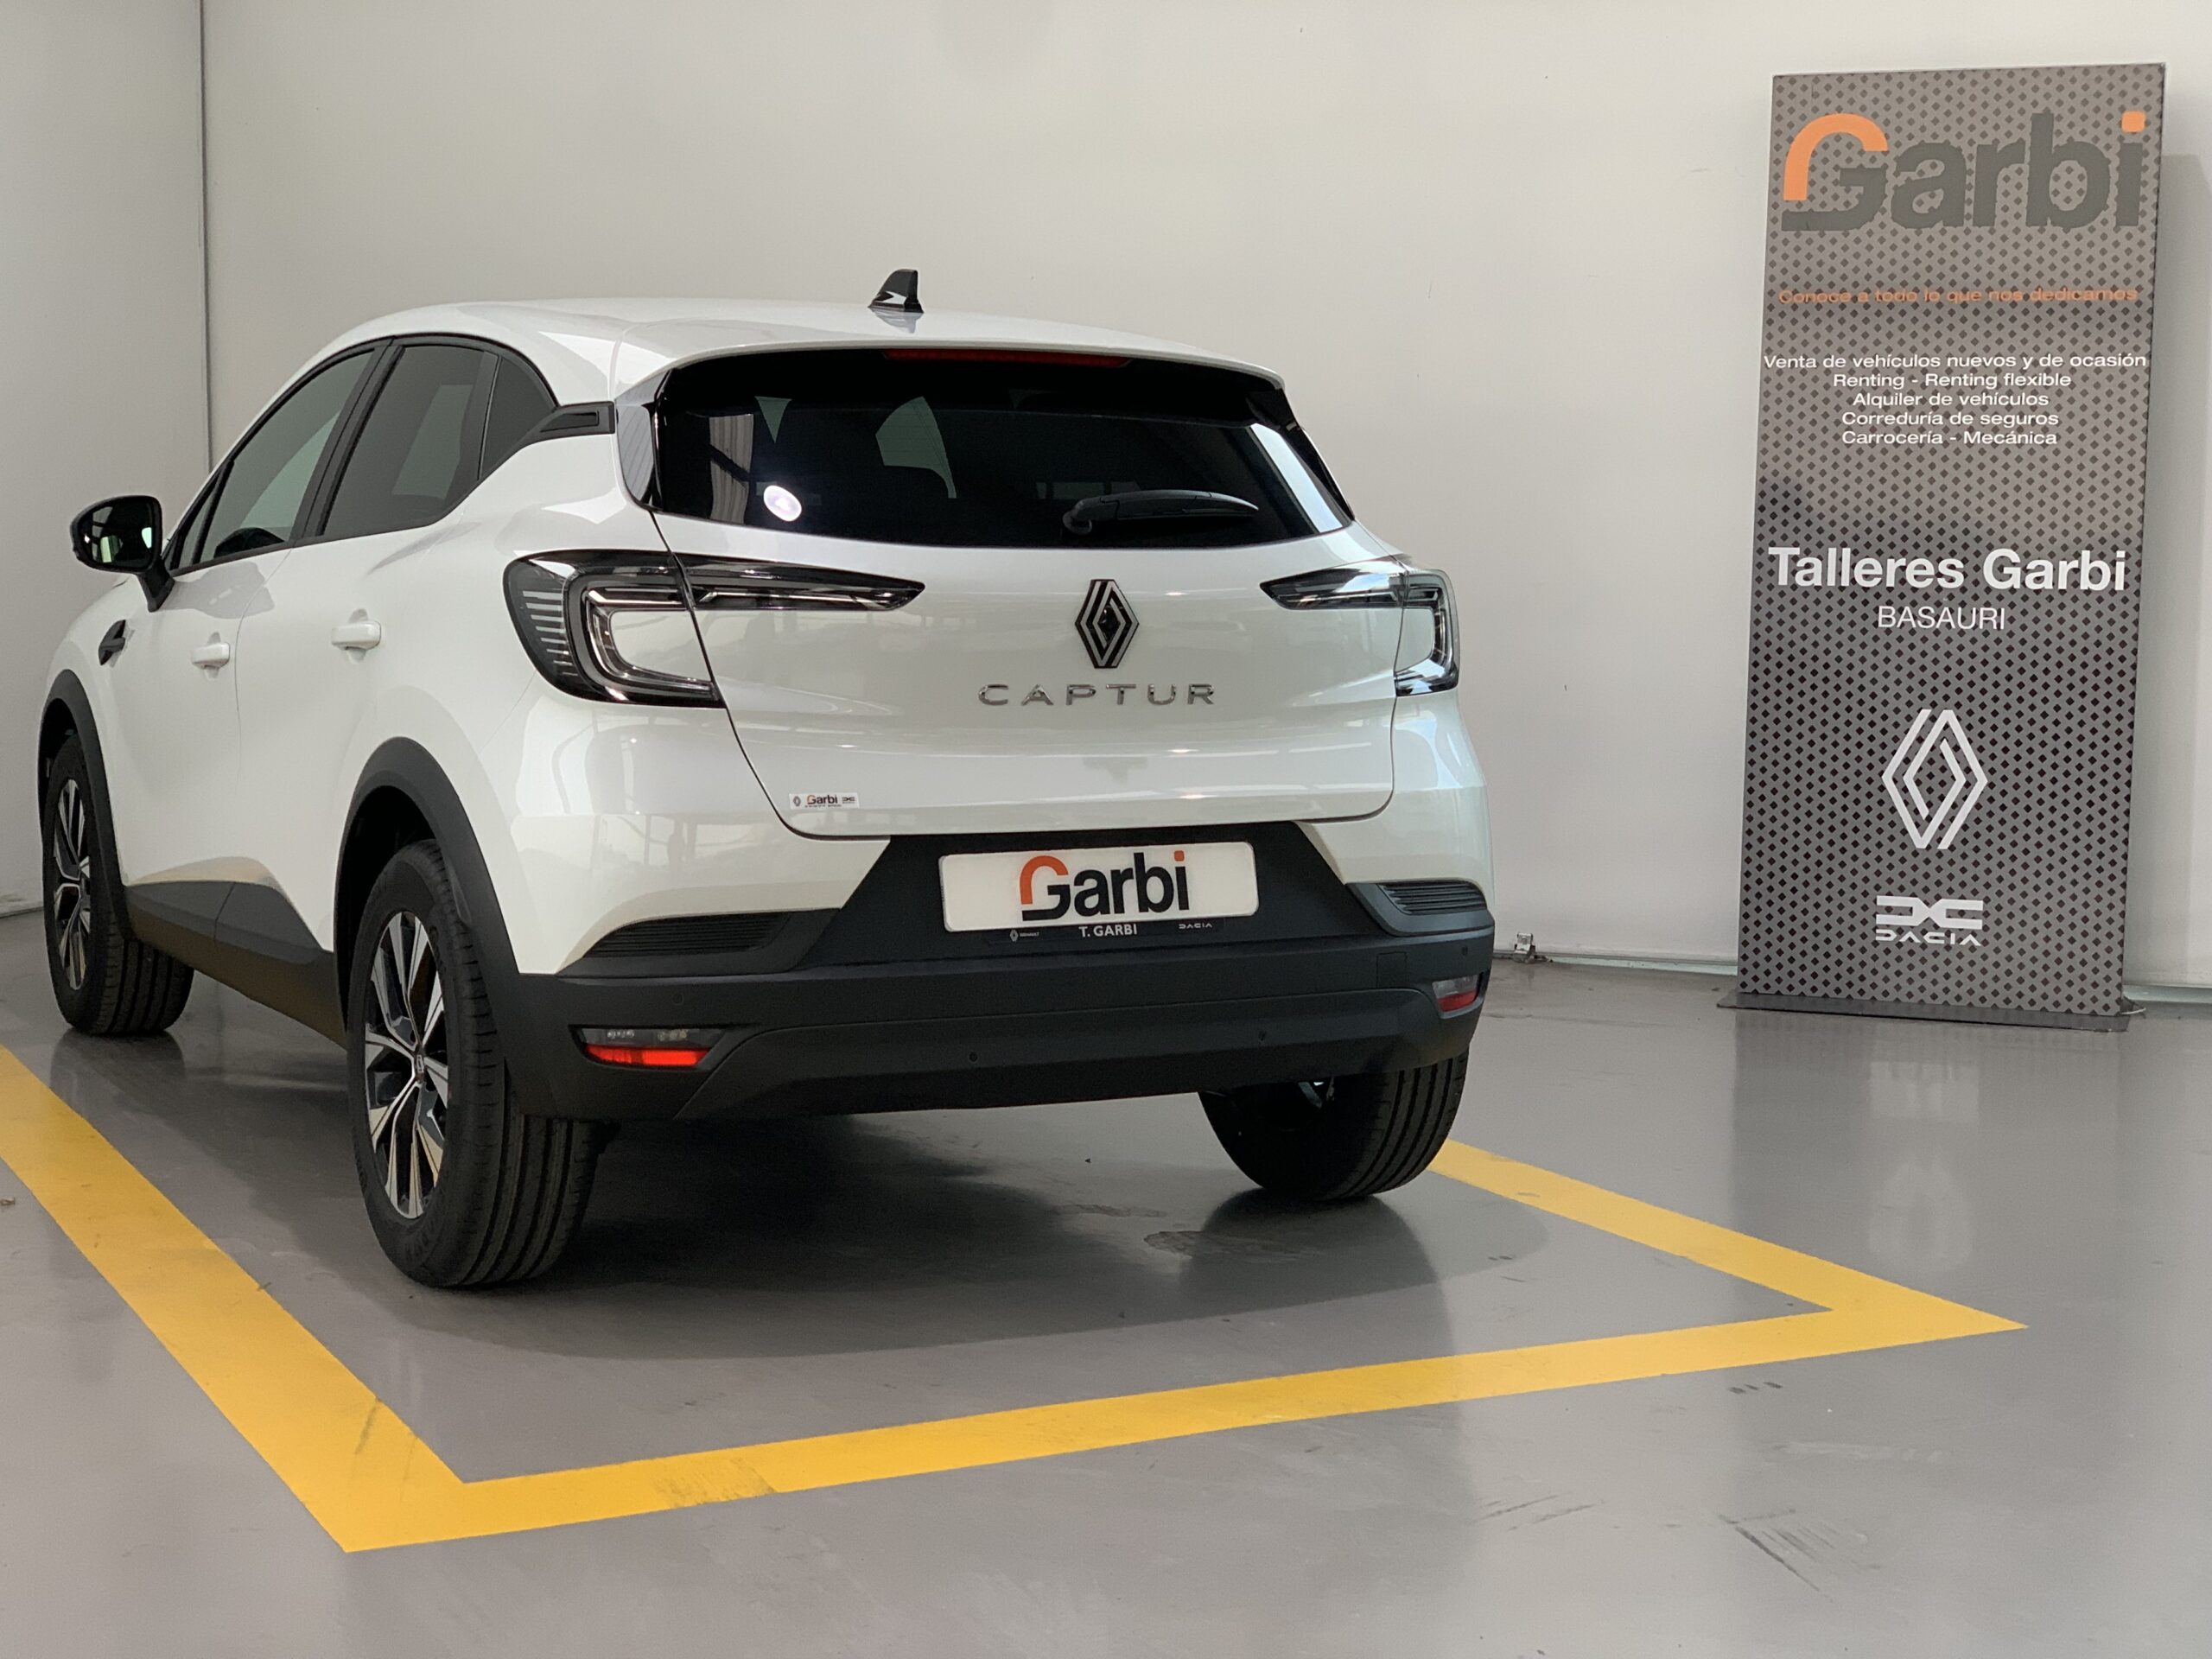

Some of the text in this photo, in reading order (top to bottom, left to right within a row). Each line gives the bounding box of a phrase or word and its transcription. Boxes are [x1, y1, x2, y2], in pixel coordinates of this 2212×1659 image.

[1782, 111, 2145, 232] Garbi
[1779, 288, 2139, 303] Conoce a todo lo que nos dedicamos
[1764, 353, 2146, 370] Venta de vehículos nuevos y de ocasión
[1833, 373, 1904, 389] Renting
[1925, 373, 1998, 389] Renting
[2004, 372, 2071, 386] flexible
[1853, 391, 2050, 410] Alquiler de vehículos
[1841, 410, 2059, 429] Correduría de seguros
[1841, 430, 1943, 445] Carrocería
[1963, 430, 2057, 445] Mecánica
[1768, 547, 2126, 590] Talleres Garbi
[1878, 606, 2005, 630] BASAURI
[978, 683, 1215, 706] CAPTUR
[806, 794, 838, 804] Garbi
[1019, 850, 1190, 922] Garbi
[1078, 923, 1138, 938] T. GARBI
[1875, 929, 1981, 946] DACIA
